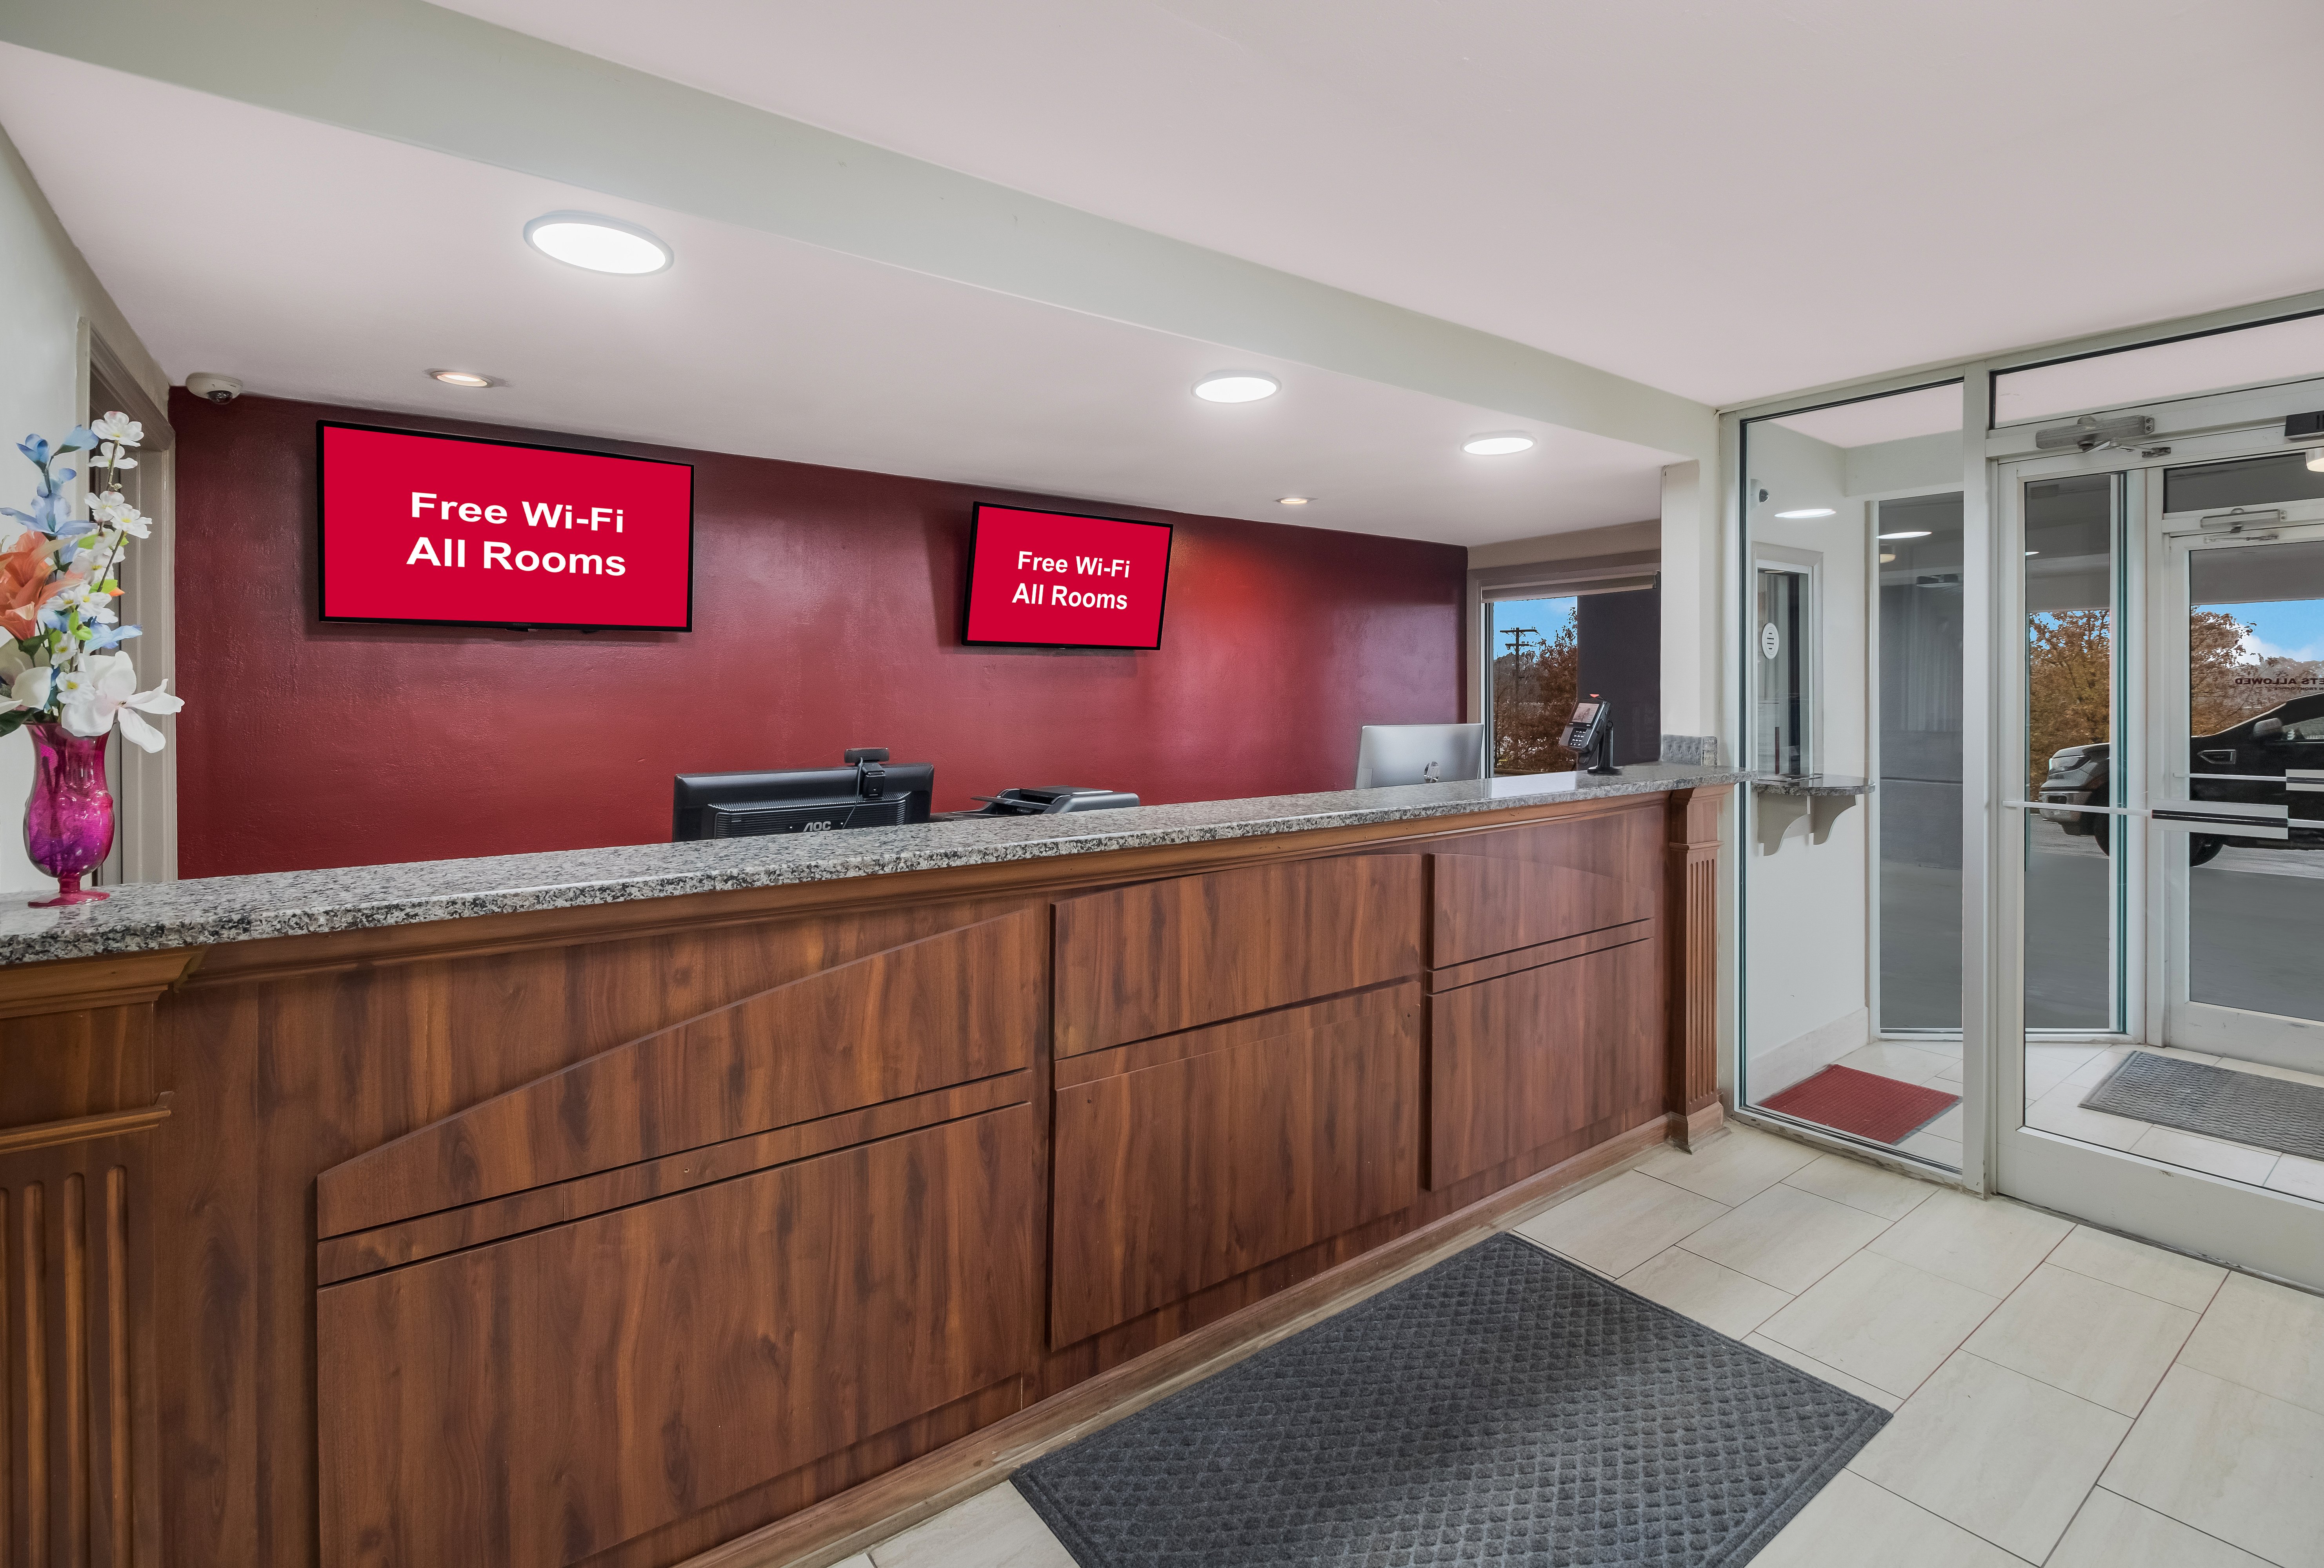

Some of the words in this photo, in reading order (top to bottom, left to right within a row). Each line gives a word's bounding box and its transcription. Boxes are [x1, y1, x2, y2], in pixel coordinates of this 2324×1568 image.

[412, 492, 507, 524] Free
[522, 501, 624, 533] Wi-Fi
[406, 537, 466, 567] All
[483, 541, 626, 576] Rooms
[1018, 551, 1068, 573] Free
[1076, 556, 1130, 578] Wi-Fi
[1012, 583, 1044, 605] All
[1051, 585, 1127, 610] Rooms
[803, 821, 831, 832] AOC
